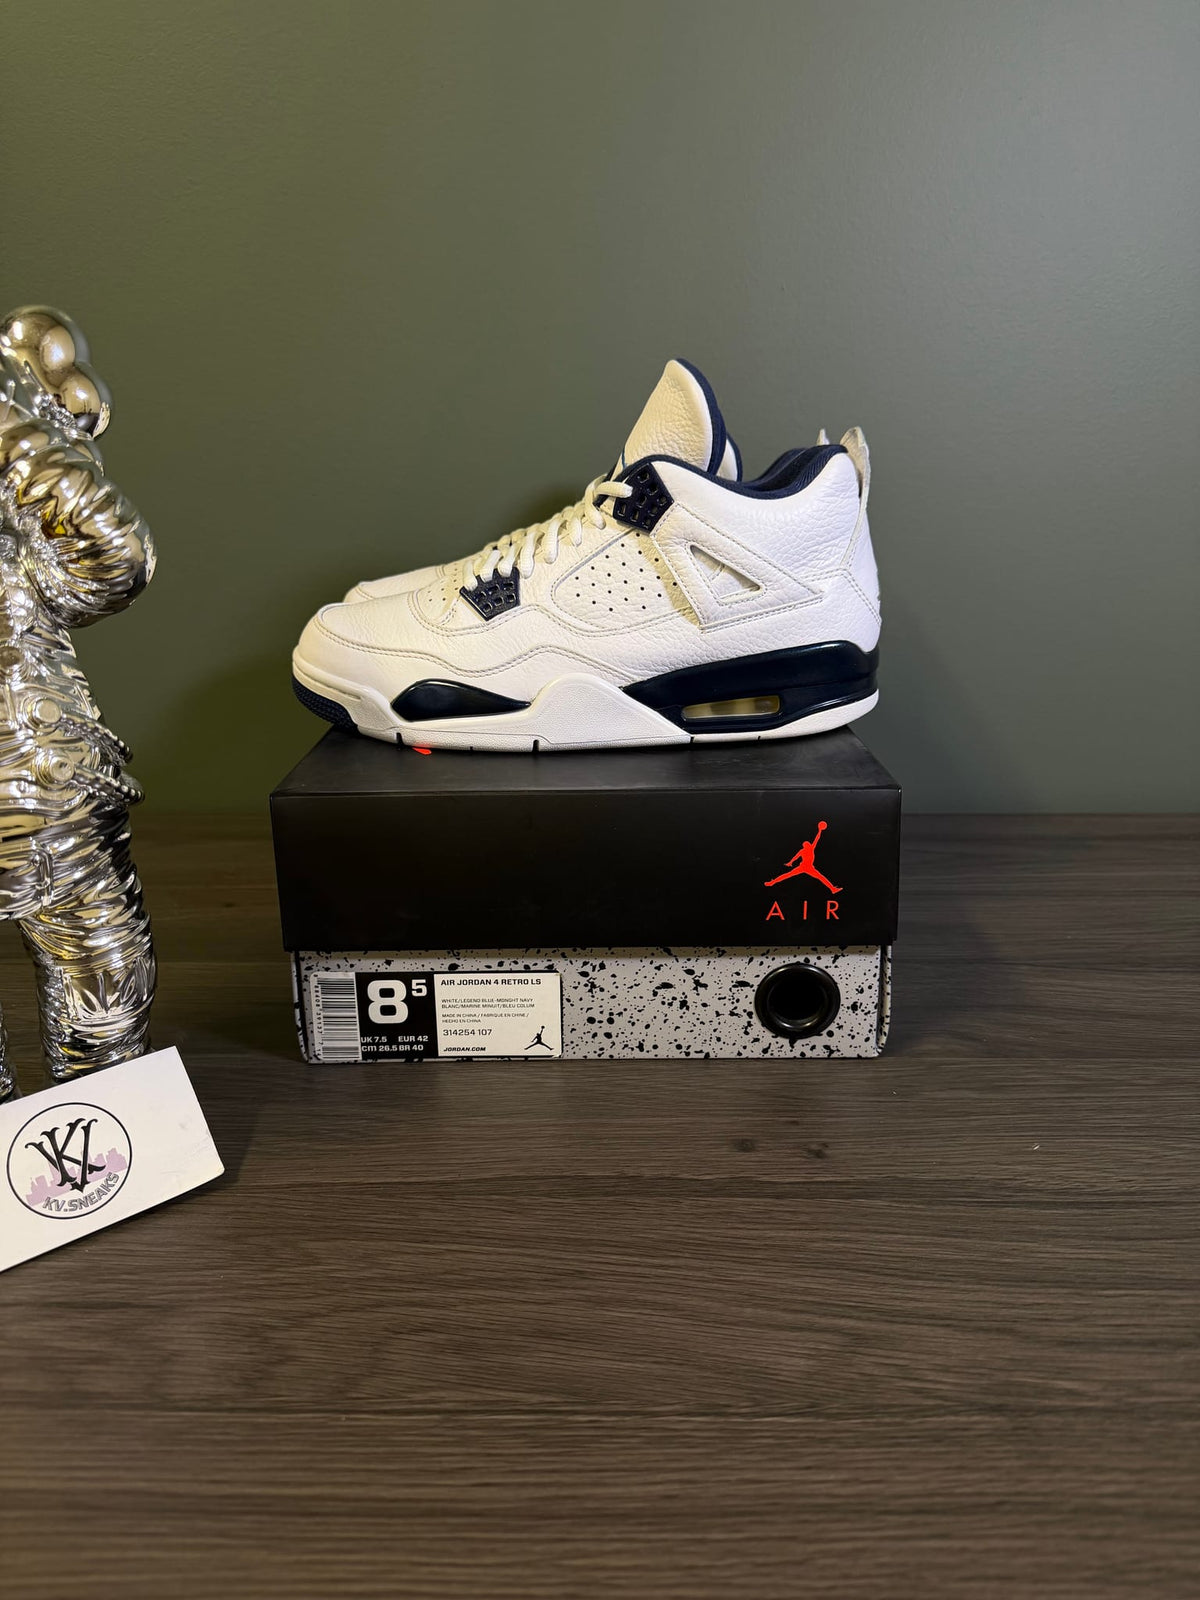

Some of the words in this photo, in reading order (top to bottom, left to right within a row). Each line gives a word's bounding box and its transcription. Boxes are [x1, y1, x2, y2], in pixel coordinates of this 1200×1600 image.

[765, 900, 840, 920] AIR
[367, 980, 409, 1024] 8
[42, 1171, 120, 1212] KV.SNEAKS
